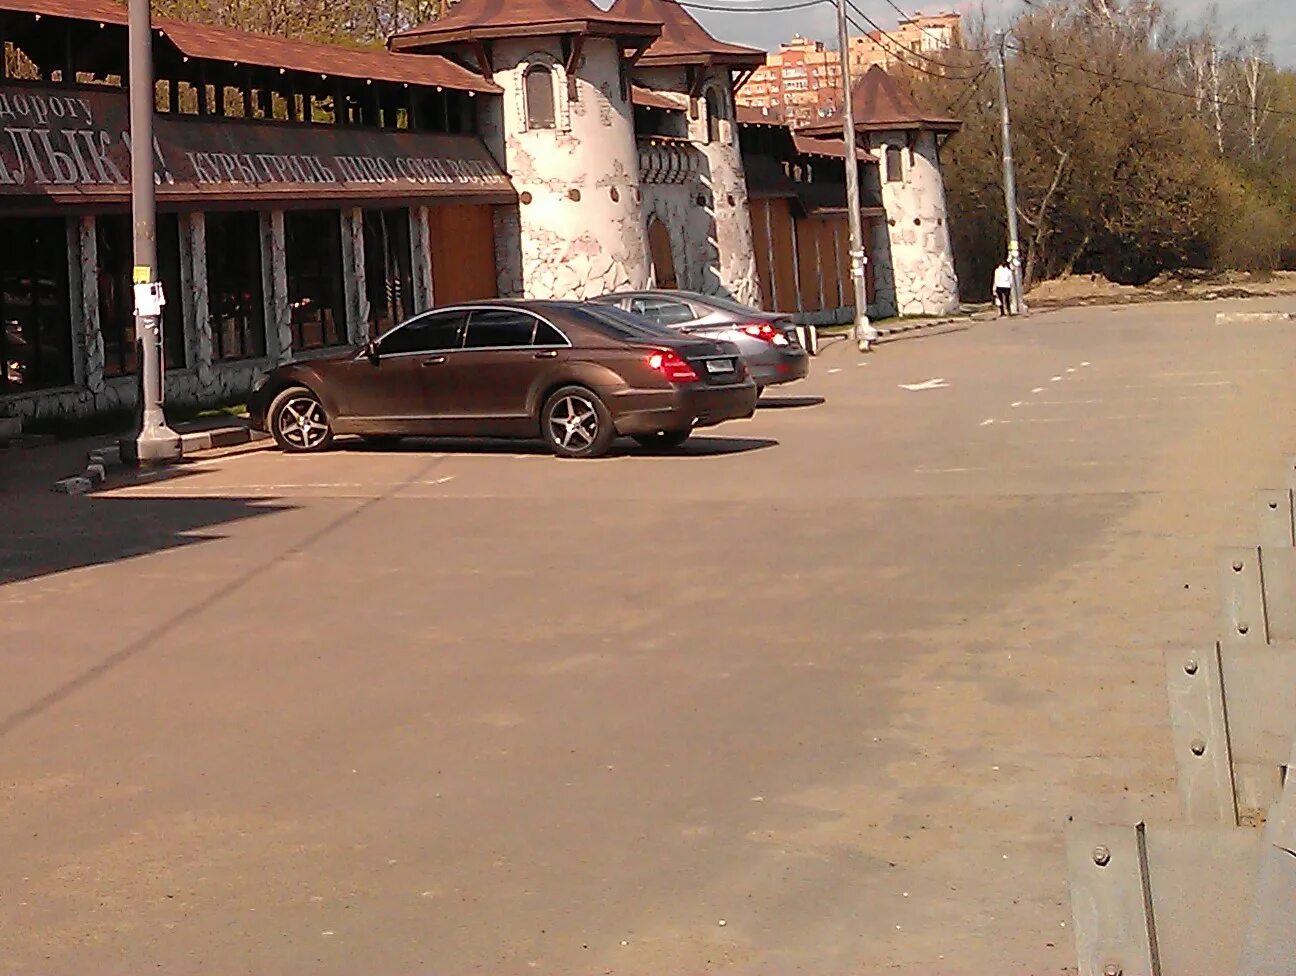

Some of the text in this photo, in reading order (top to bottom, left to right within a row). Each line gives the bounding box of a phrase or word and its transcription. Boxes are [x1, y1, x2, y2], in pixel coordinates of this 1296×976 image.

[185, 152, 263, 184] КУРЫ
[256, 154, 336, 184] ГРИЛЬ
[333, 155, 398, 184] ПИВО
